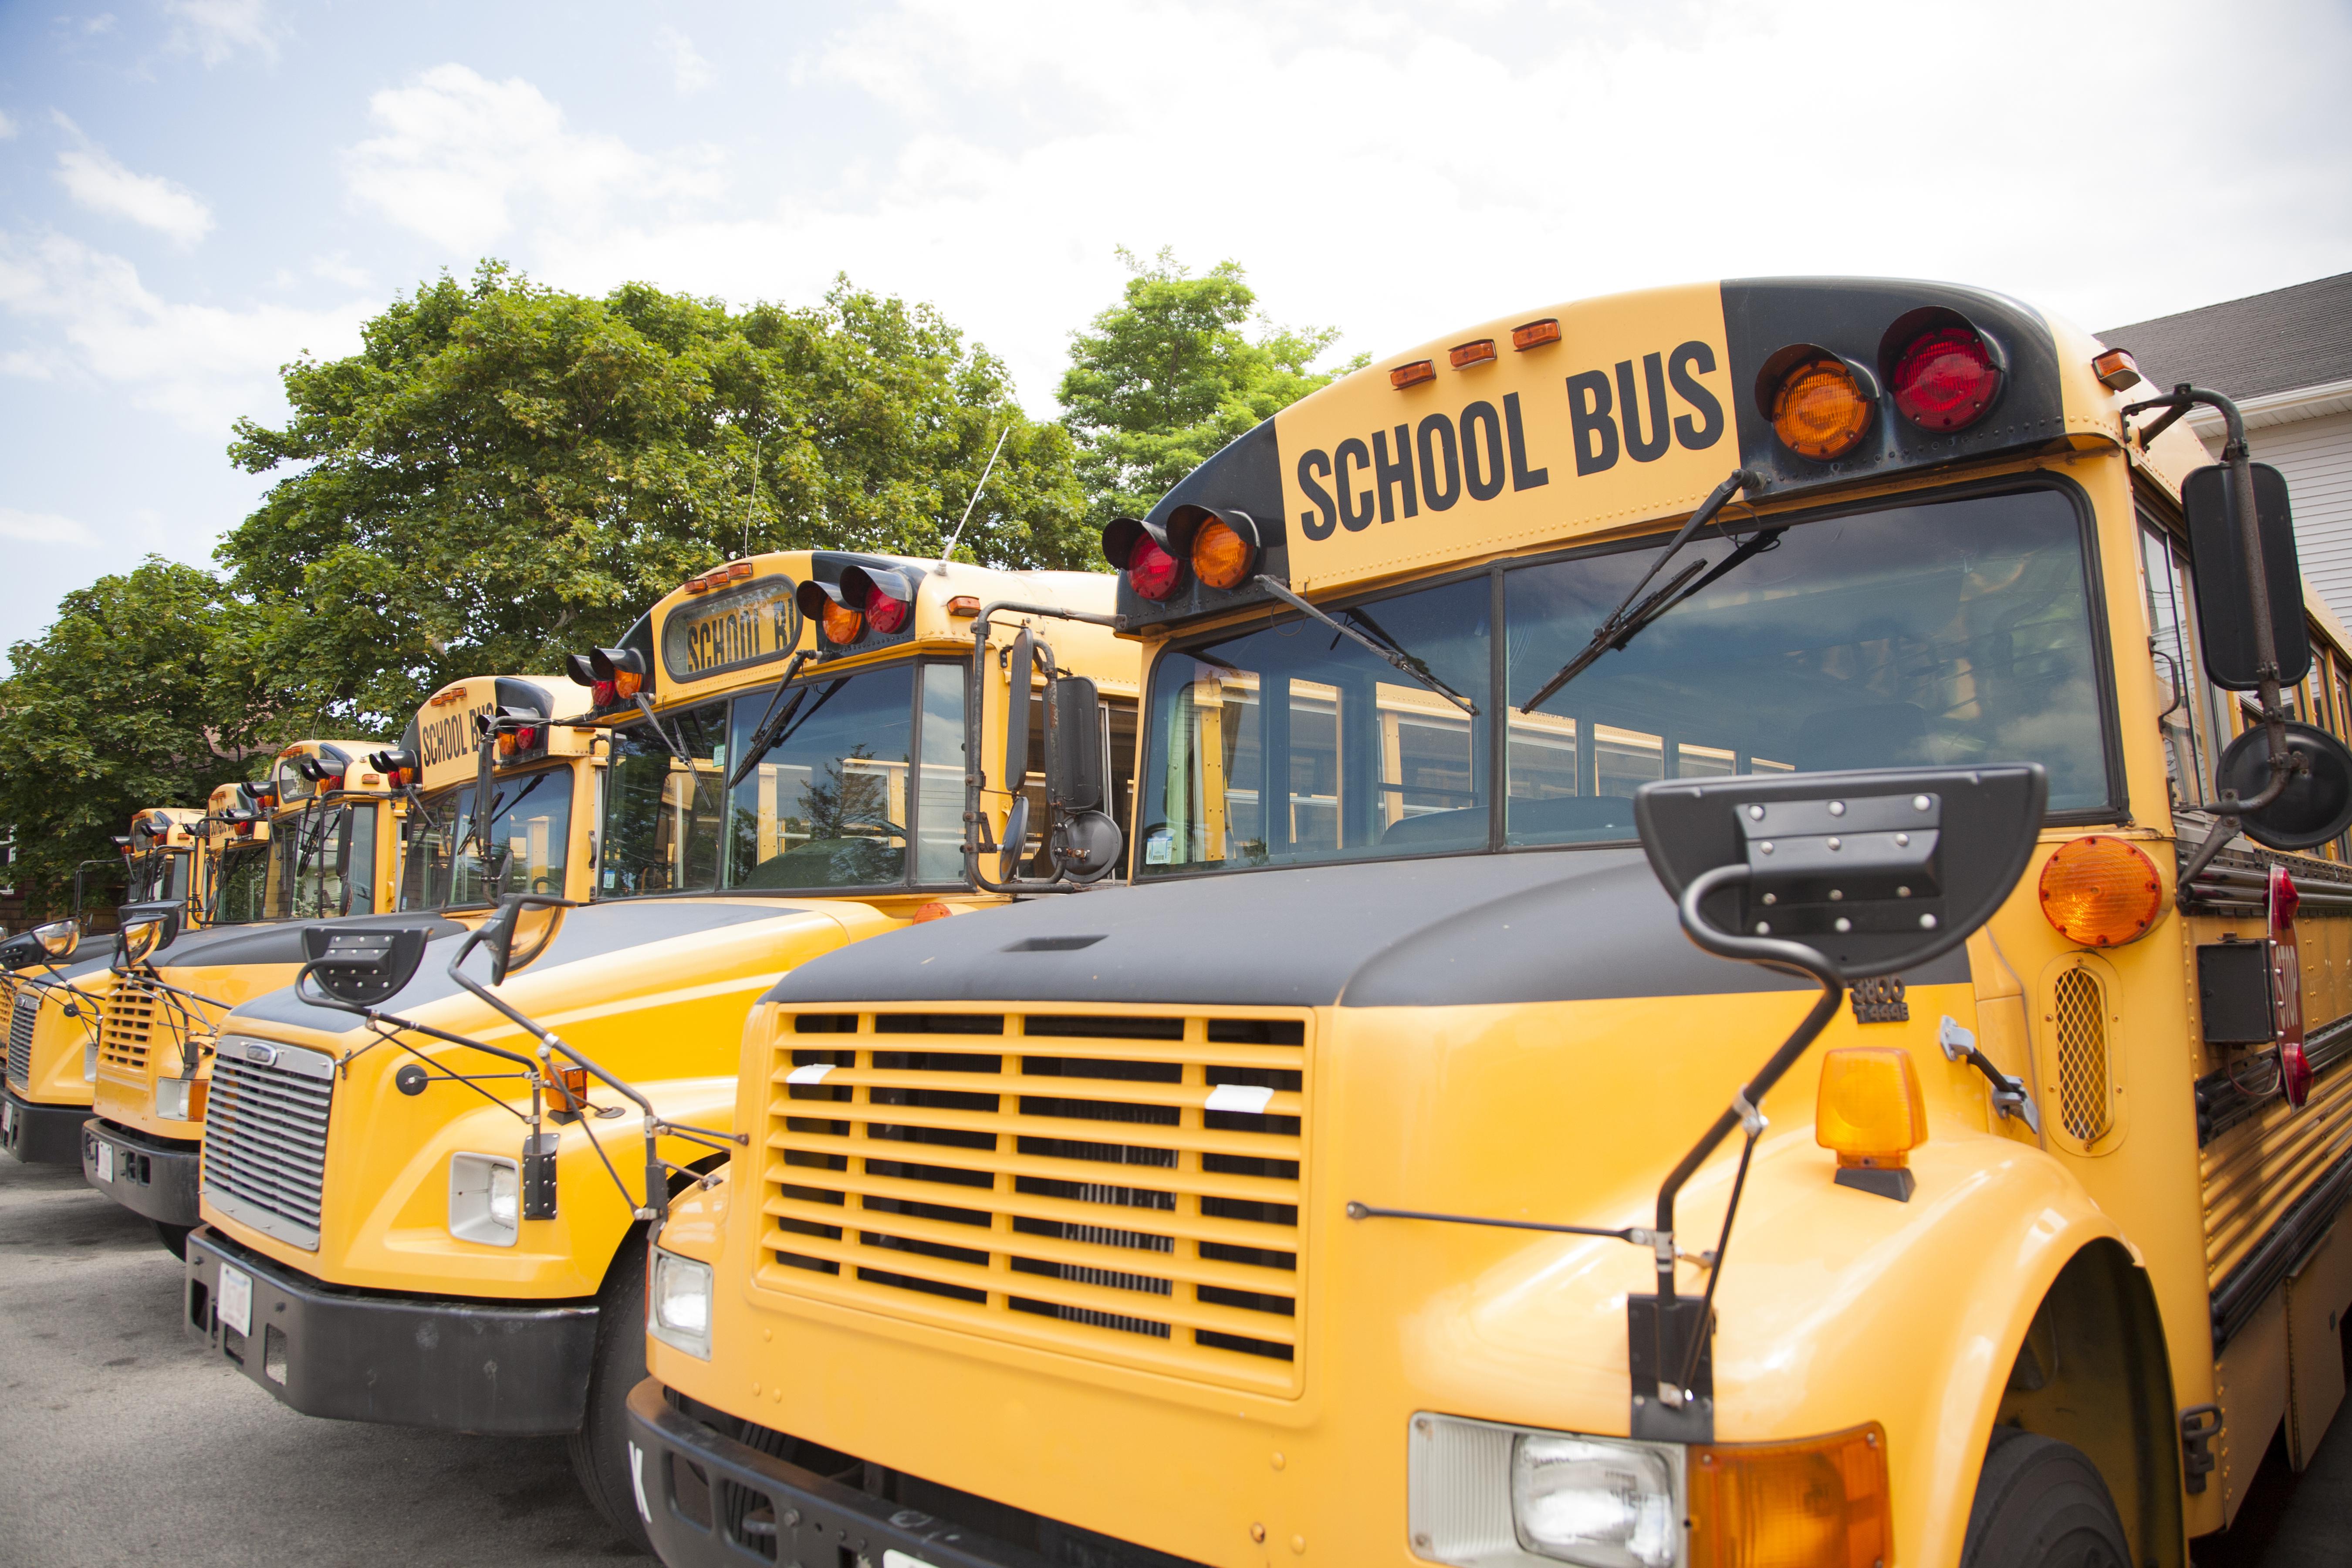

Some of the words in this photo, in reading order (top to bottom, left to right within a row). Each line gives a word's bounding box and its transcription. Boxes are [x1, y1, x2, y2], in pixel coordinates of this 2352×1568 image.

[1297, 391, 1549, 541] SCHOOL
[1566, 341, 1725, 477] BUS
[423, 713, 467, 767] SCHOOL
[2275, 945, 2298, 1031] STOP
